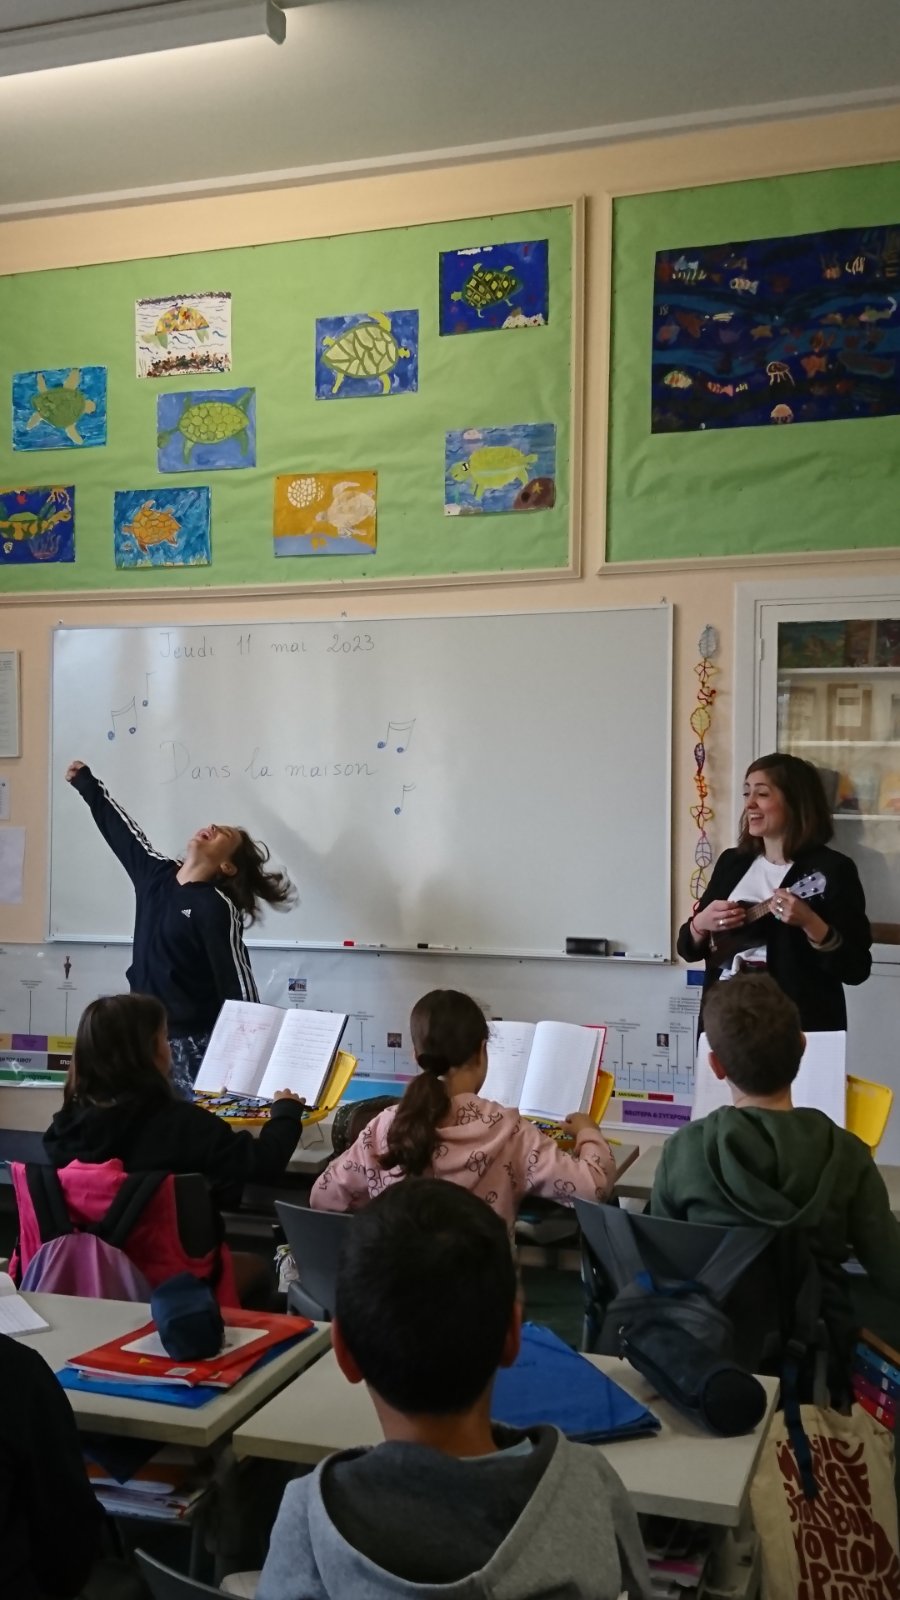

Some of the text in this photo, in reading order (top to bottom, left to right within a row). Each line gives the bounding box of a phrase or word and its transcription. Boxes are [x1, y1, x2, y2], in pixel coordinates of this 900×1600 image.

[159, 631, 375, 659] Jeudi 11 mai 2023
[160, 740, 377, 785] Dans la maison
